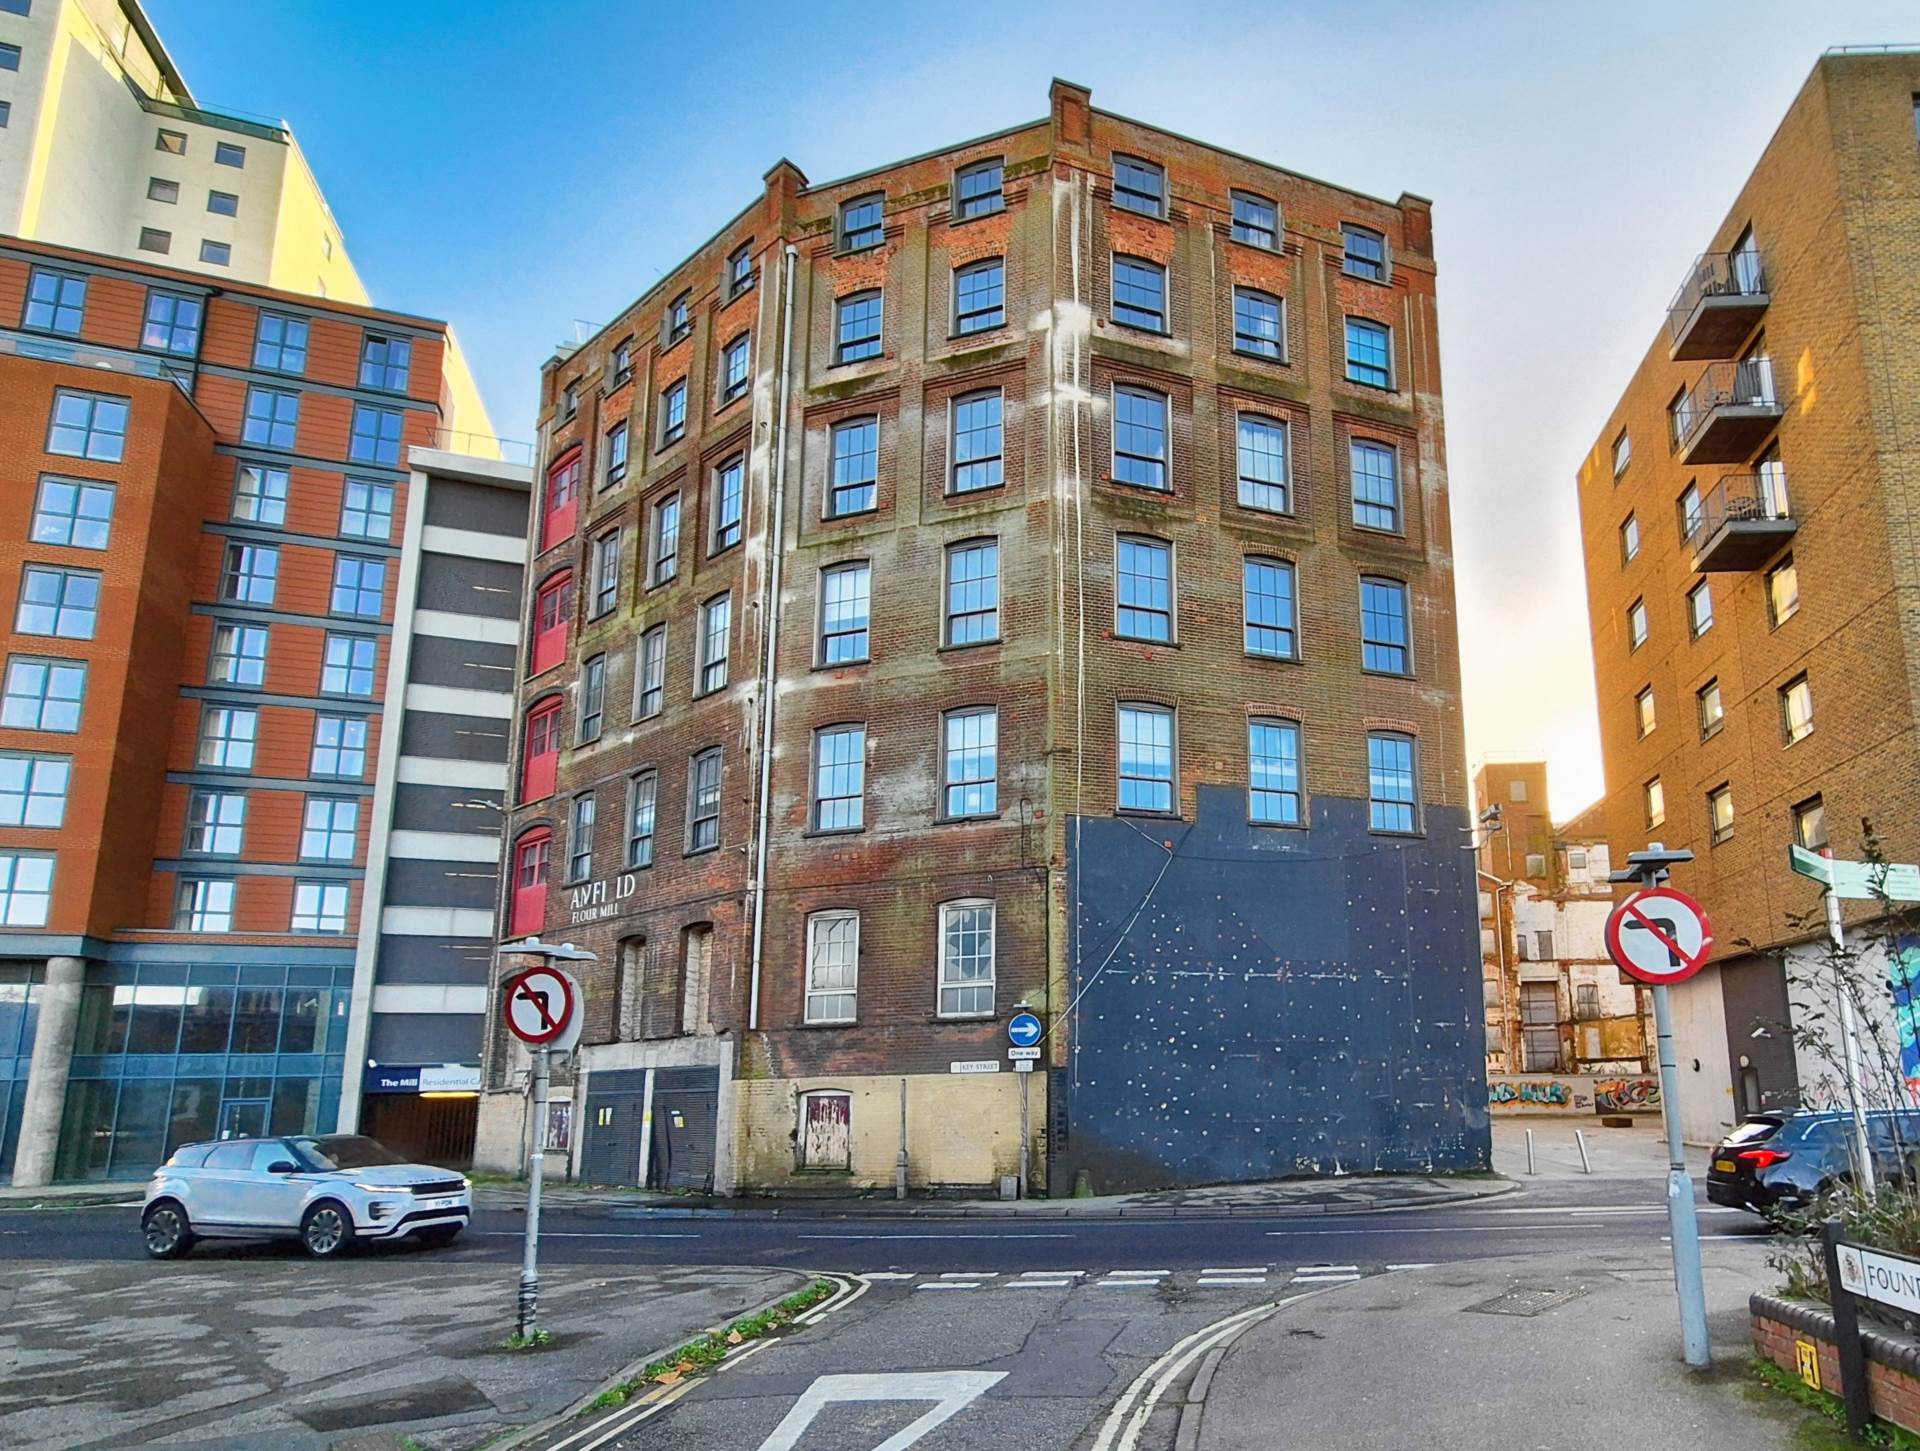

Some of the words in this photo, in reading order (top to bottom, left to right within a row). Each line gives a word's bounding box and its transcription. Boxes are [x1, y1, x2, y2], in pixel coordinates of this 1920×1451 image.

[572, 907, 598, 924] FLOUR
[600, 902, 619, 918] MILL
[962, 1063, 974, 1071] KEY
[381, 1079, 399, 1087] The
[400, 1079, 418, 1087] Mill
[422, 1077, 469, 1087] Residential
